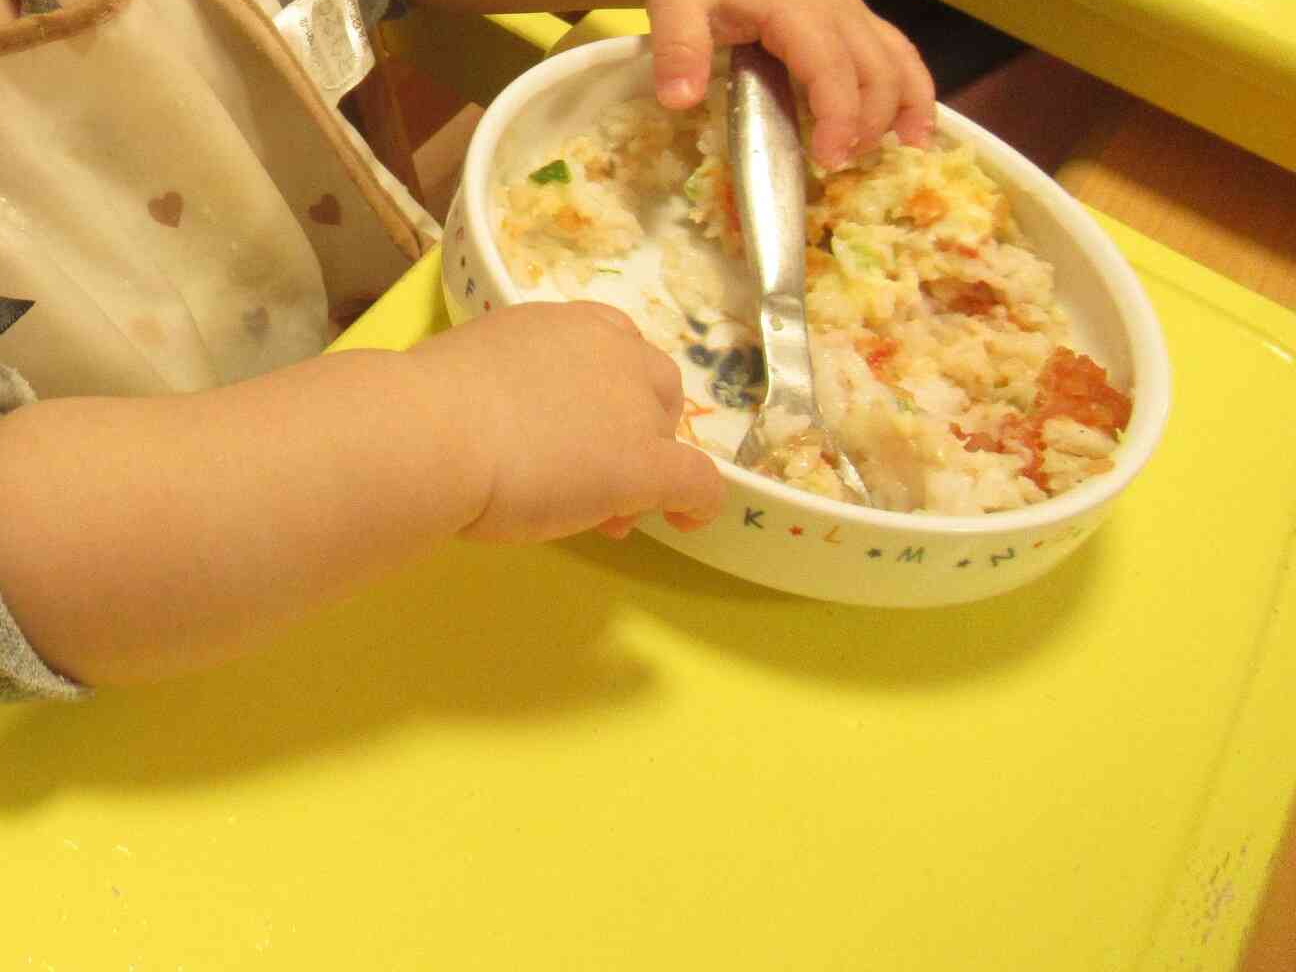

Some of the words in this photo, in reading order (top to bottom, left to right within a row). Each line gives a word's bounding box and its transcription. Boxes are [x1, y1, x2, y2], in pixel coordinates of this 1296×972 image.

[744, 507, 764, 528] K
[823, 525, 843, 544] L
[896, 546, 925, 565] M
[990, 547, 1015, 567] N
